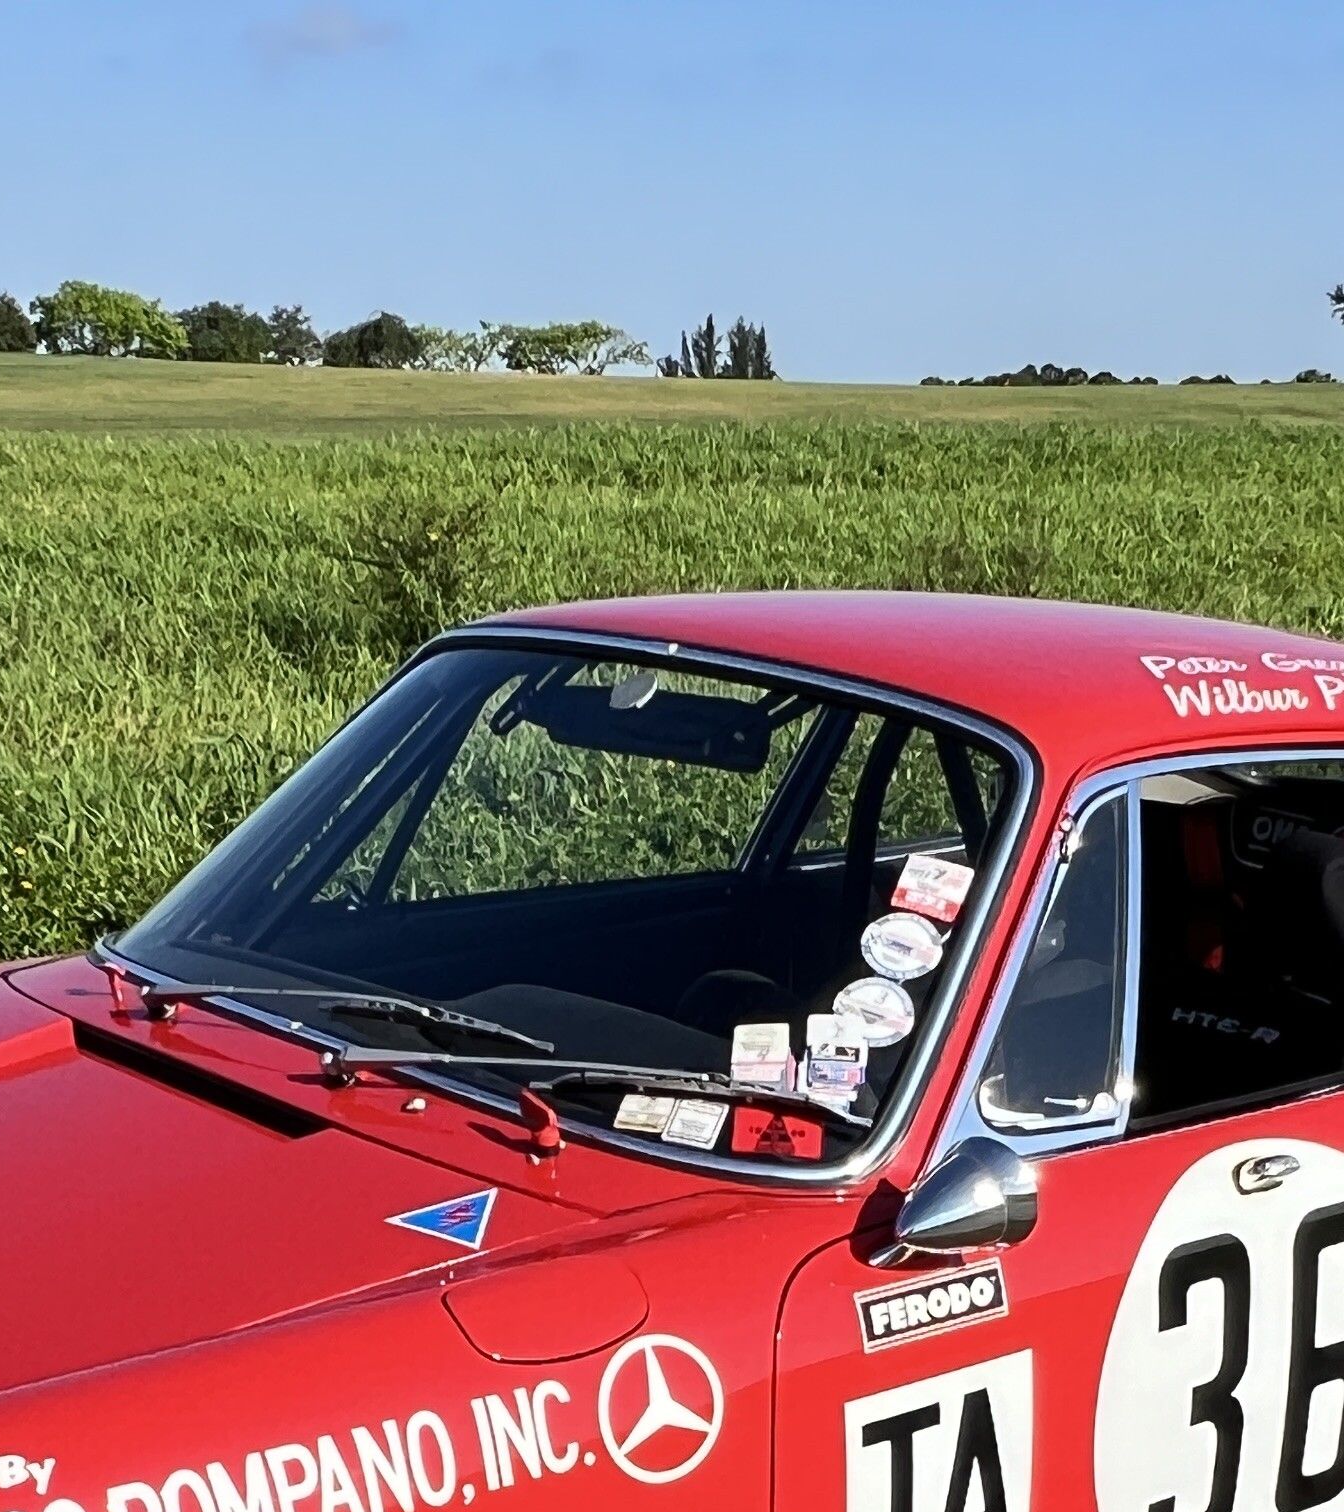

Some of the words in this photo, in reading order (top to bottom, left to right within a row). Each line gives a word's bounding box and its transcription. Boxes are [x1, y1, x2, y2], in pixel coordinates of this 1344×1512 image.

[1140, 655, 1247, 680] Peter
[1163, 678, 1309, 717] Wilbur
[869, 1276, 996, 1336] FERODO
[471, 1380, 597, 1491] INC.
